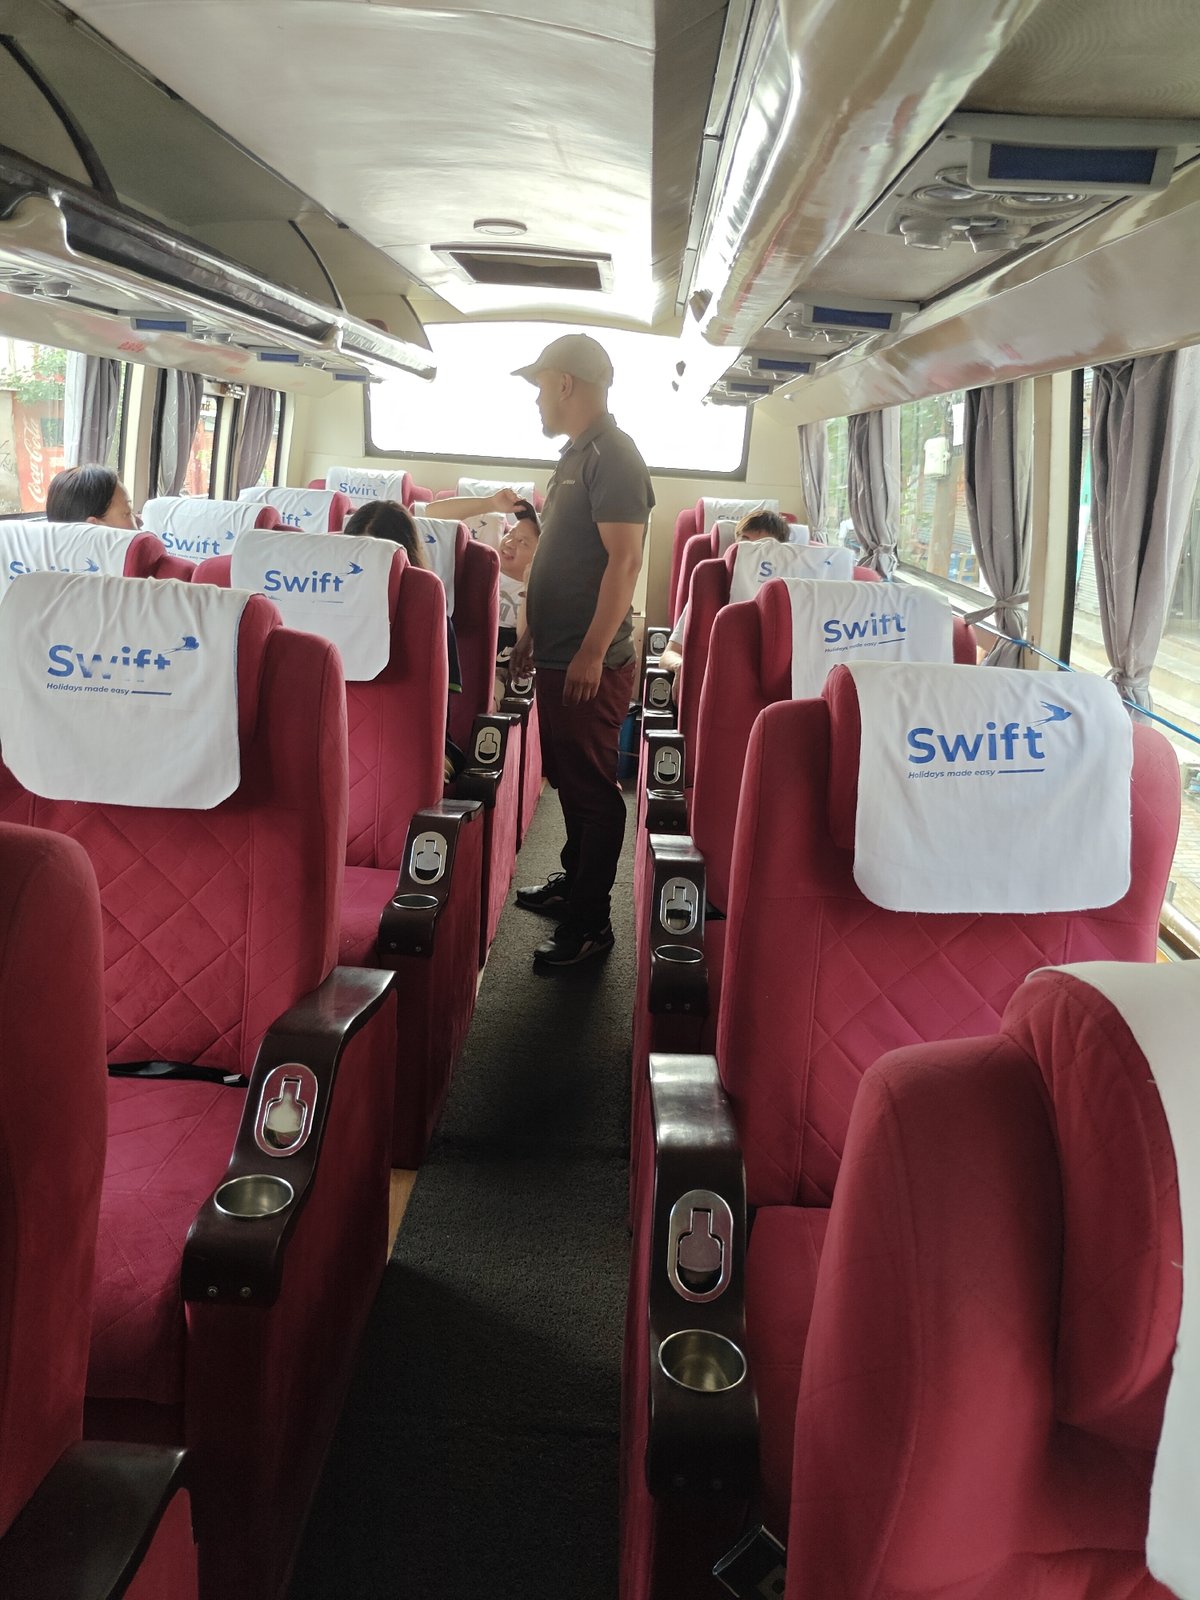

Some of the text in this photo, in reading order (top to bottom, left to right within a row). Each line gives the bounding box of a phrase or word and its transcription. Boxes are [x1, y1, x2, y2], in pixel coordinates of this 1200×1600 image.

[281, 511, 301, 528] ift
[161, 532, 221, 556] Swift
[263, 569, 345, 594] Swift
[823, 611, 906, 644] Swift
[46, 682, 130, 696] Holidays made easy
[907, 721, 1046, 764] Swift
[908, 769, 996, 779] Holidays made easy
